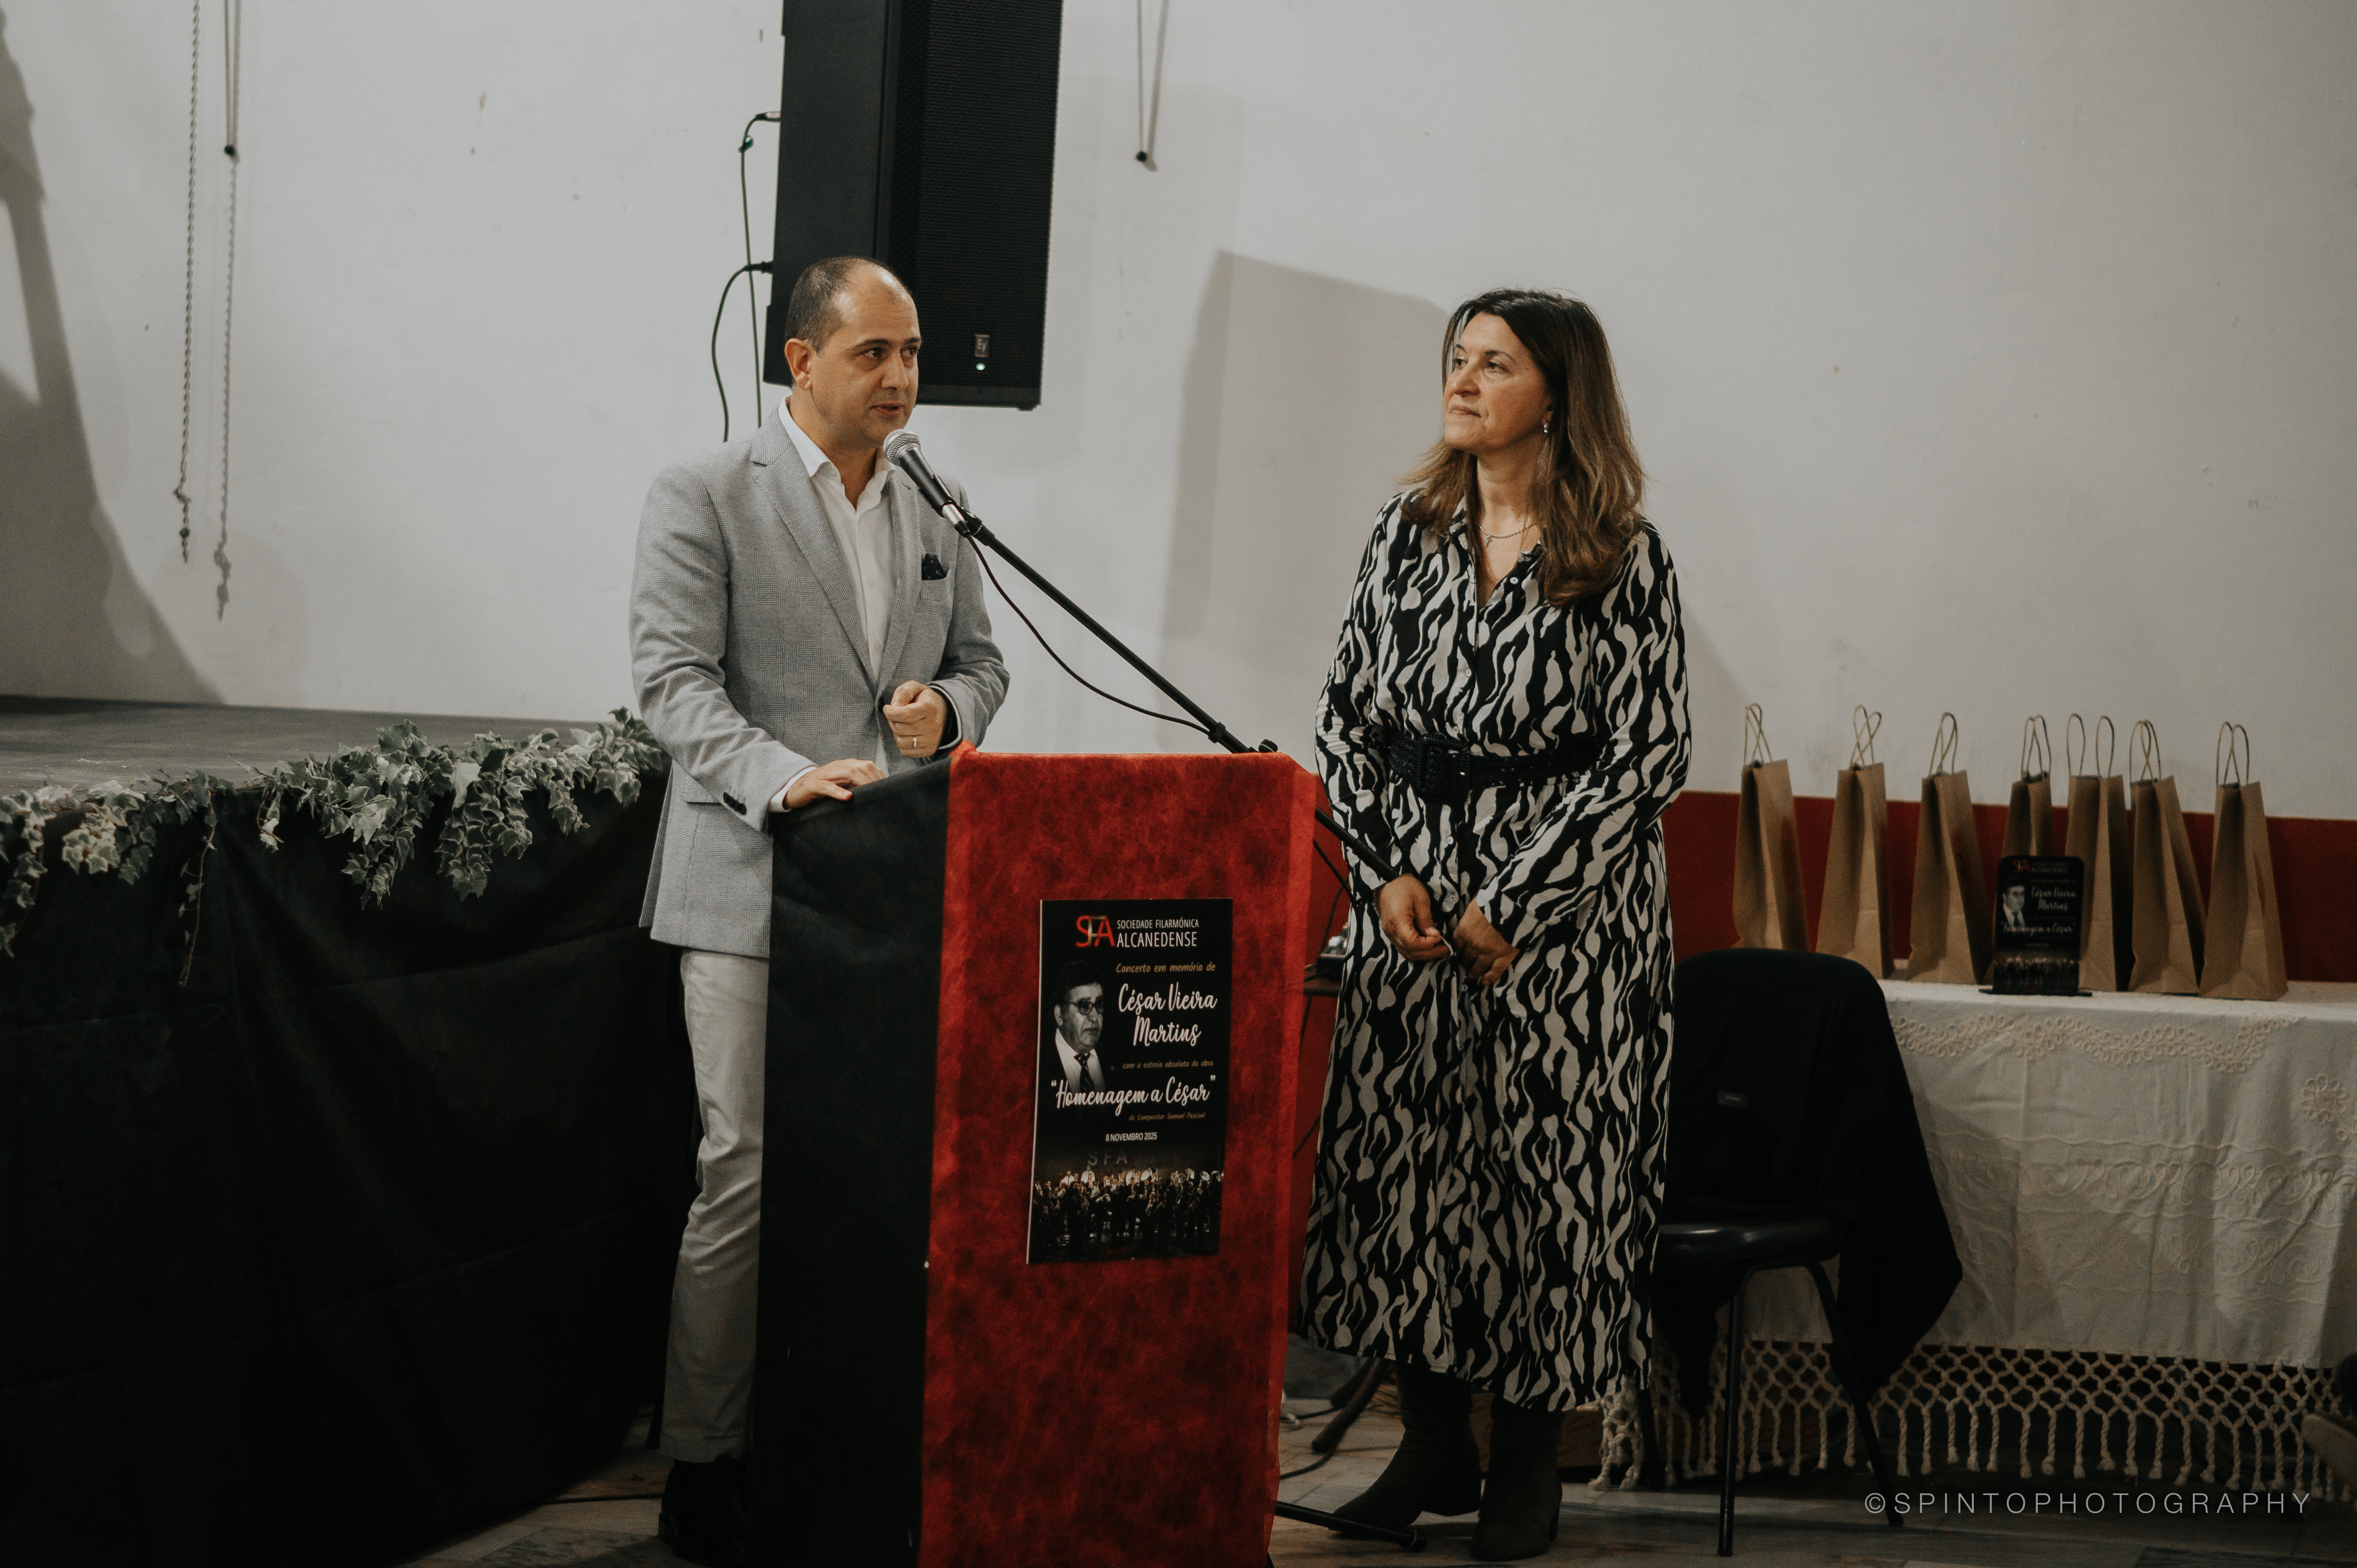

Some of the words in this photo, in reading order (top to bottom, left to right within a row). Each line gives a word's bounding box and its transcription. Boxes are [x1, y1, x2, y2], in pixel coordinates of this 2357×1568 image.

[1117, 919, 1153, 929] SOCIEDADE
[1155, 917, 1199, 928] FILARMÓNICA
[1117, 931, 1197, 947] ALCANEDENSE
[1116, 963, 1150, 973] Concerto
[1170, 962, 1203, 972] memória
[1206, 961, 1215, 971] de
[1119, 983, 1166, 1015] César
[1169, 982, 1218, 1011] Vieira
[1133, 1015, 1201, 1046] Martins
[1165, 1060, 1189, 1068] absoluta
[1200, 1059, 1214, 1067] obra
[1151, 1088, 1162, 1102] a
[1110, 1132, 1143, 1141] NOVEMBRO
[1144, 1131, 1157, 1140] 2025
